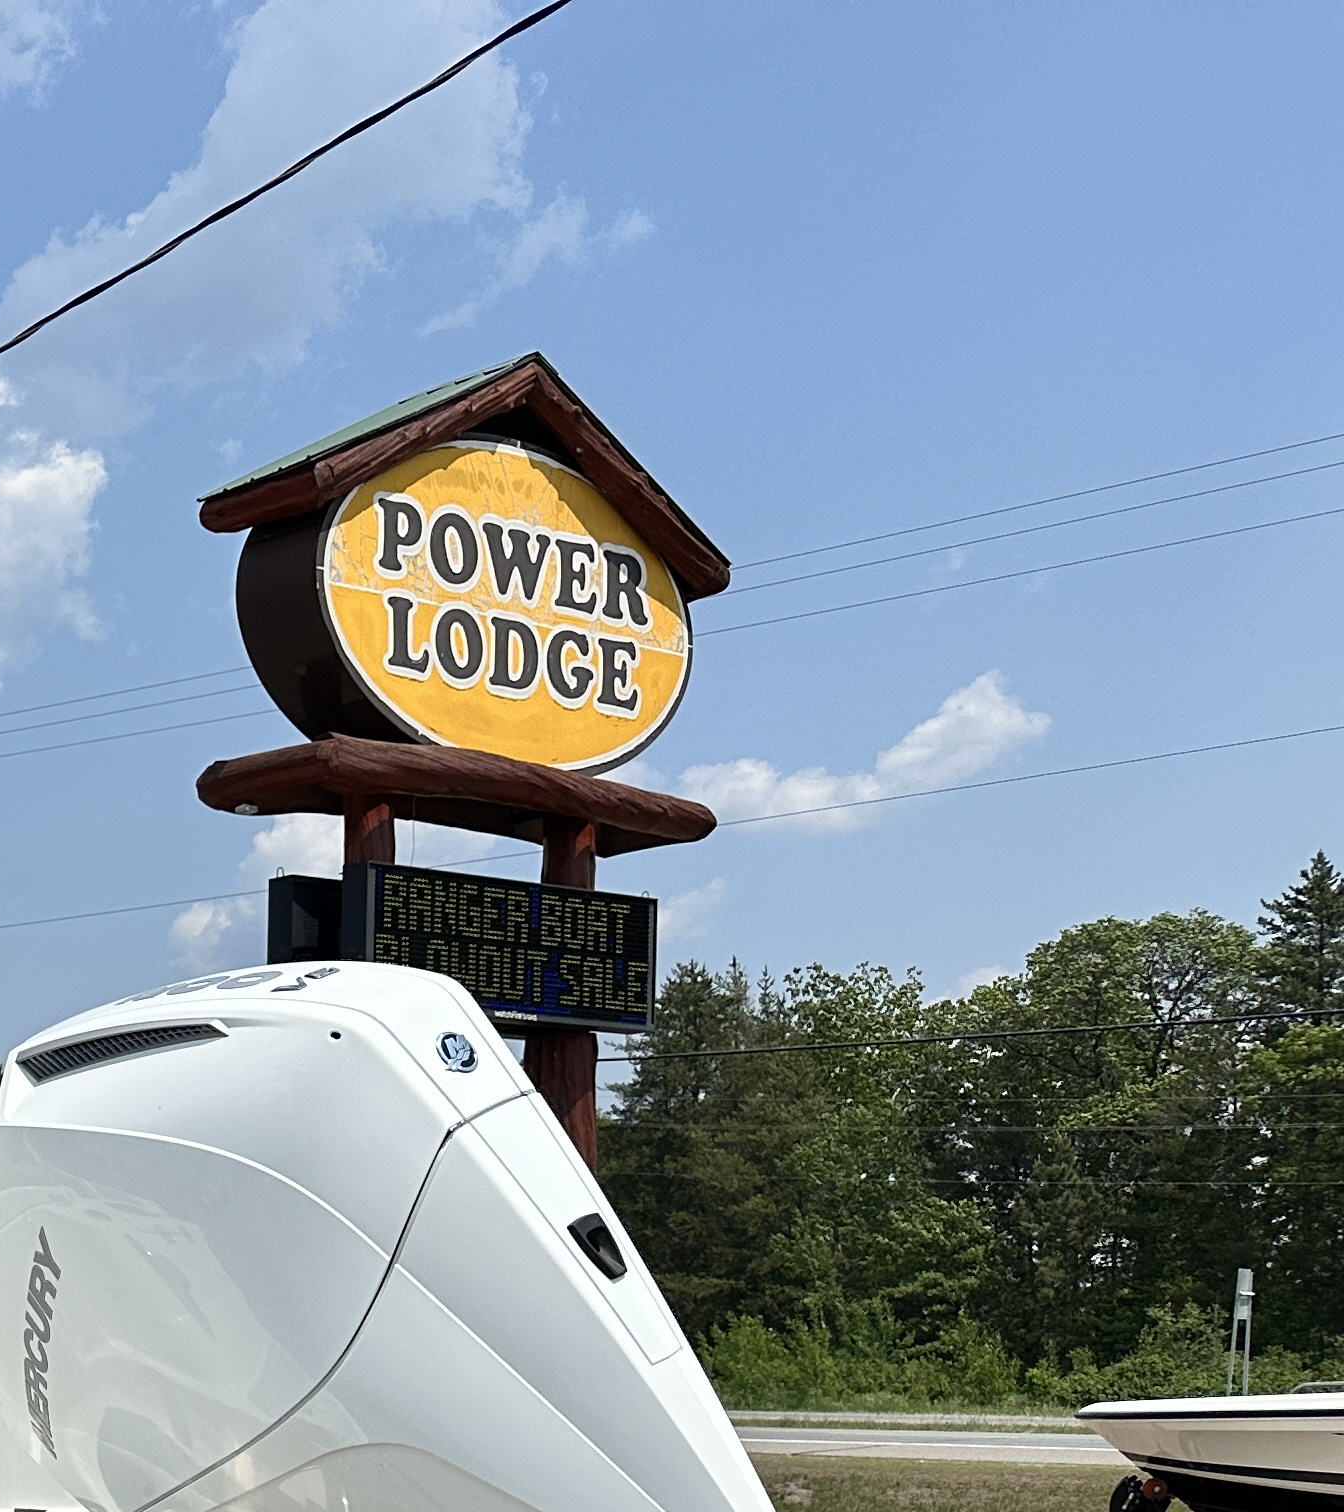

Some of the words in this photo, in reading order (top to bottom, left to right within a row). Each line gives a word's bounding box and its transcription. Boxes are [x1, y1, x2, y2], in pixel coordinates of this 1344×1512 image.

[378, 498, 649, 626] POWER
[387, 596, 638, 711] LODGE
[383, 873, 530, 943] RANGER
[540, 894, 631, 953] BOAT
[559, 954, 649, 1013] SALE
[23, 1225, 62, 1461] MERCURY
